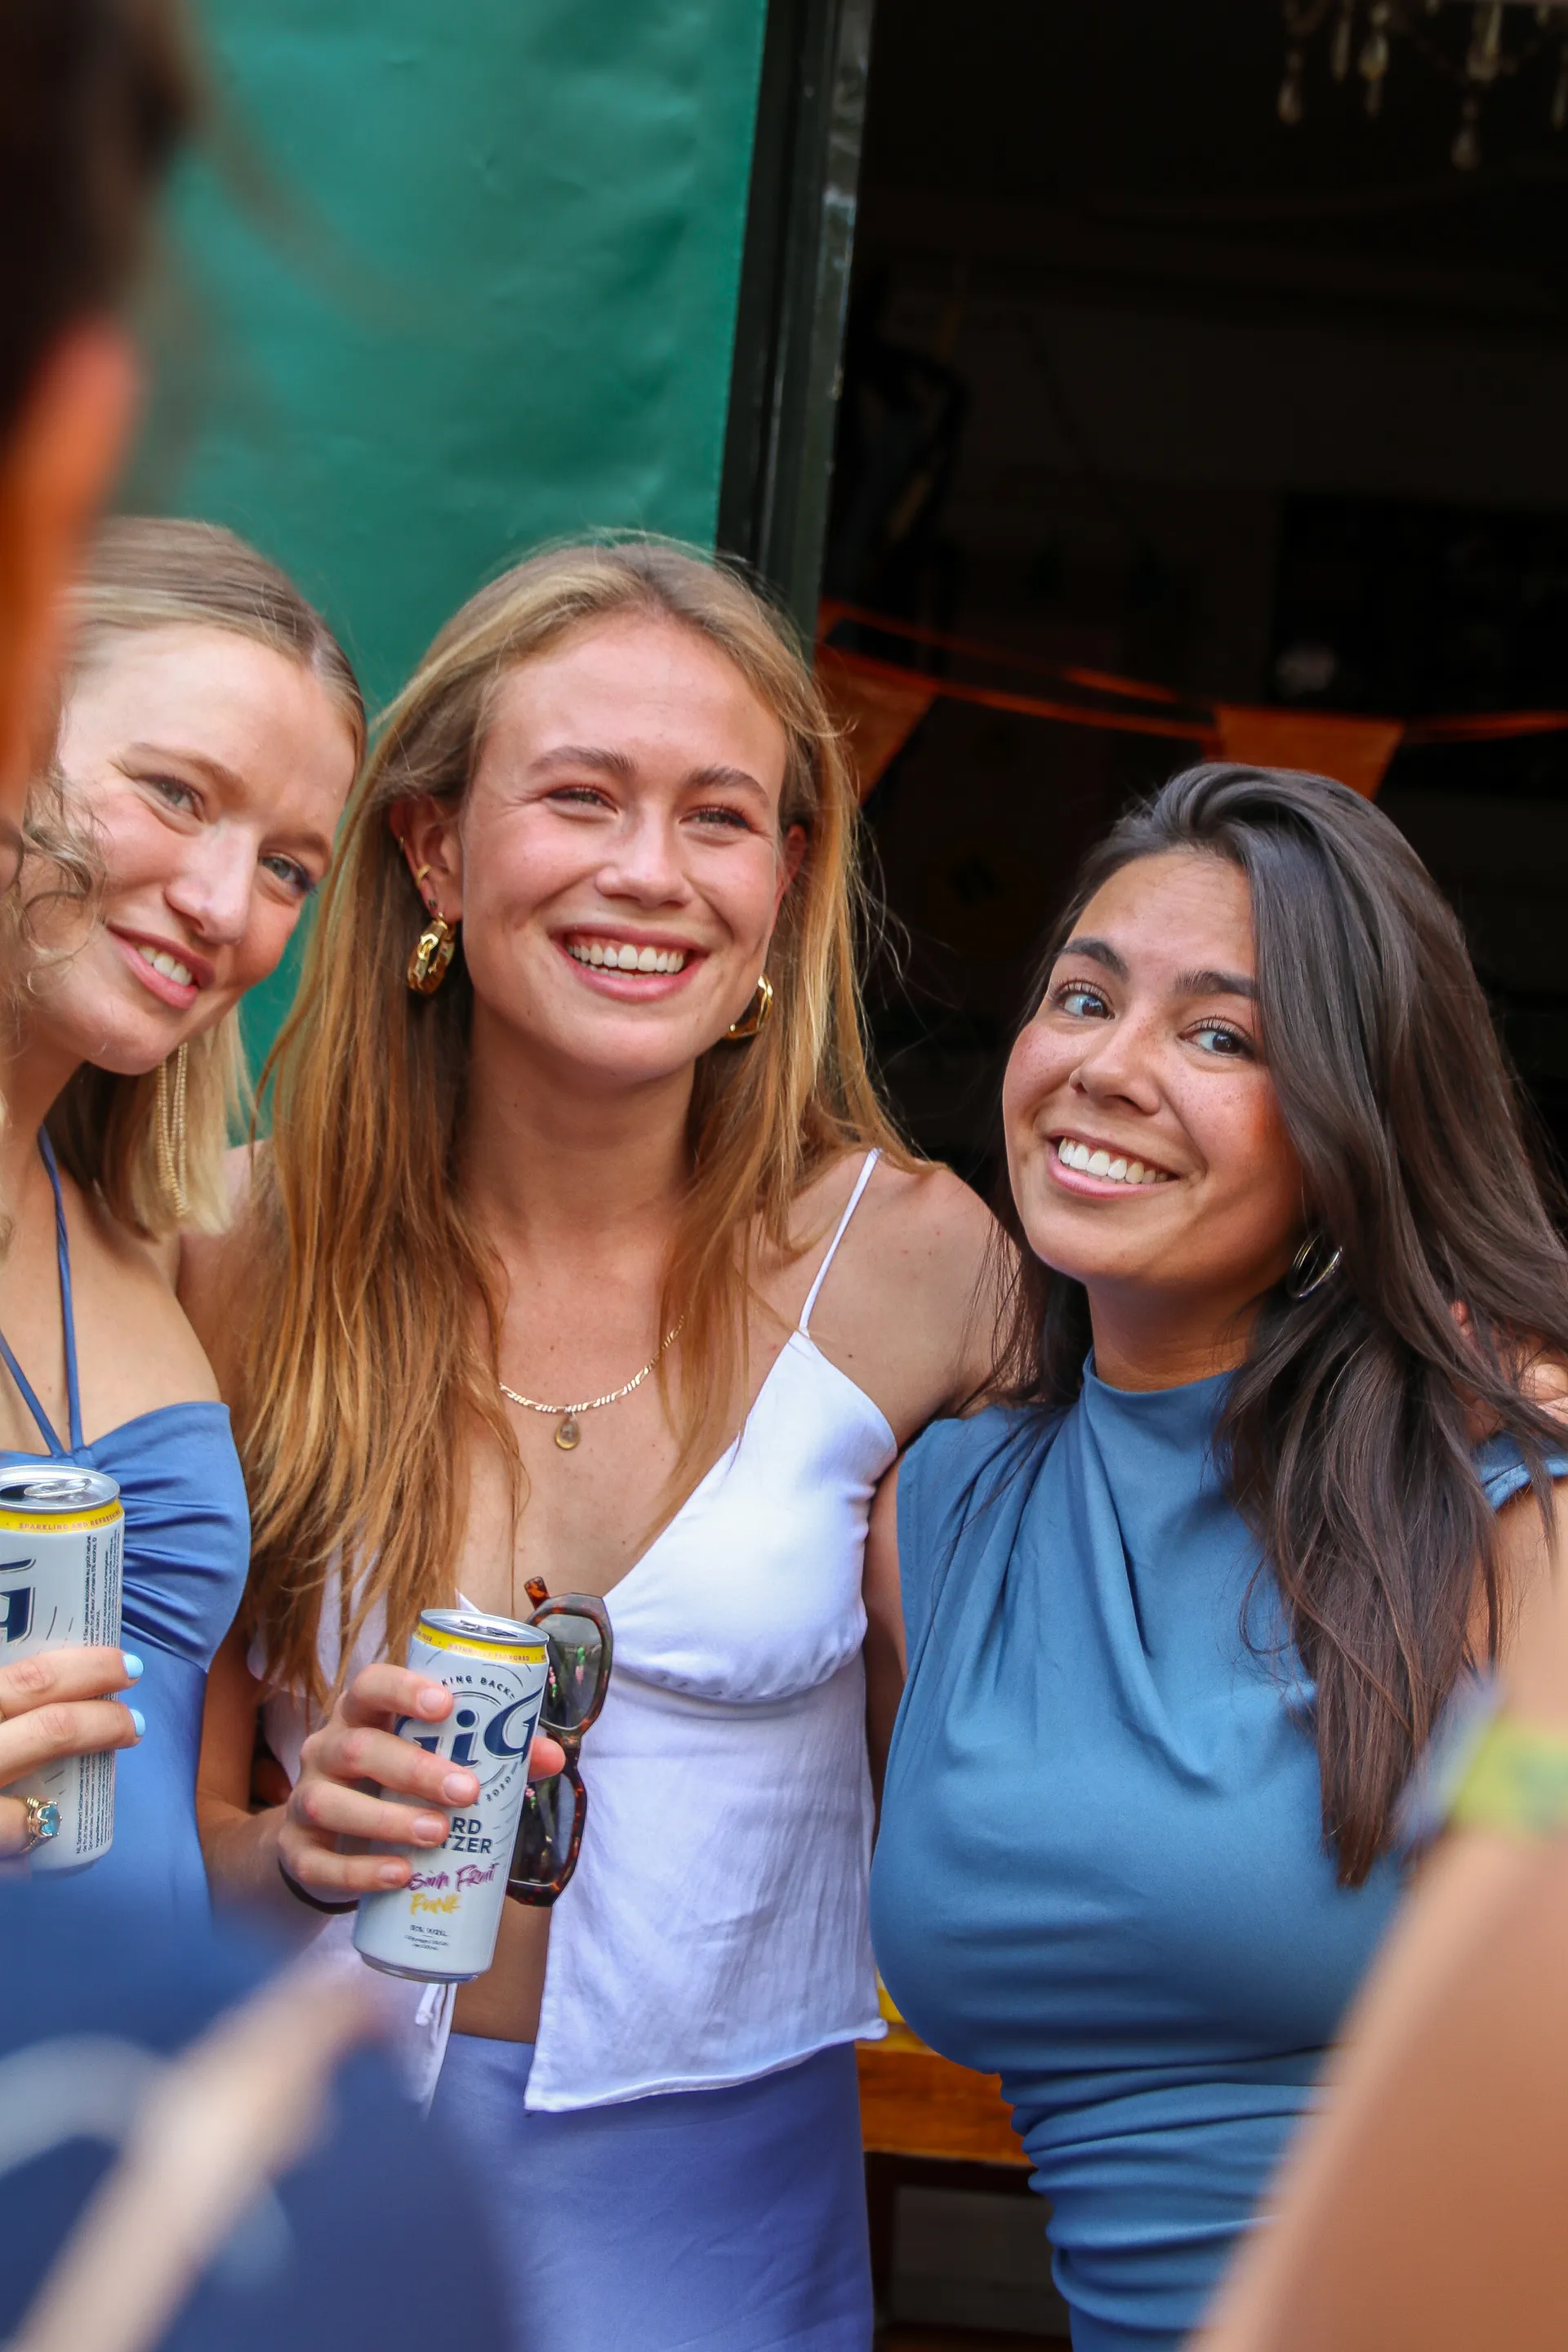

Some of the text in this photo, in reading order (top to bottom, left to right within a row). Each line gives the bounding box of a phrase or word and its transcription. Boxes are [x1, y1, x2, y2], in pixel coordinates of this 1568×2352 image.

[19, 1522, 68, 1530] SPARKLING
[480, 1677, 510, 1695] BACK
[451, 1816, 481, 1835] RD
